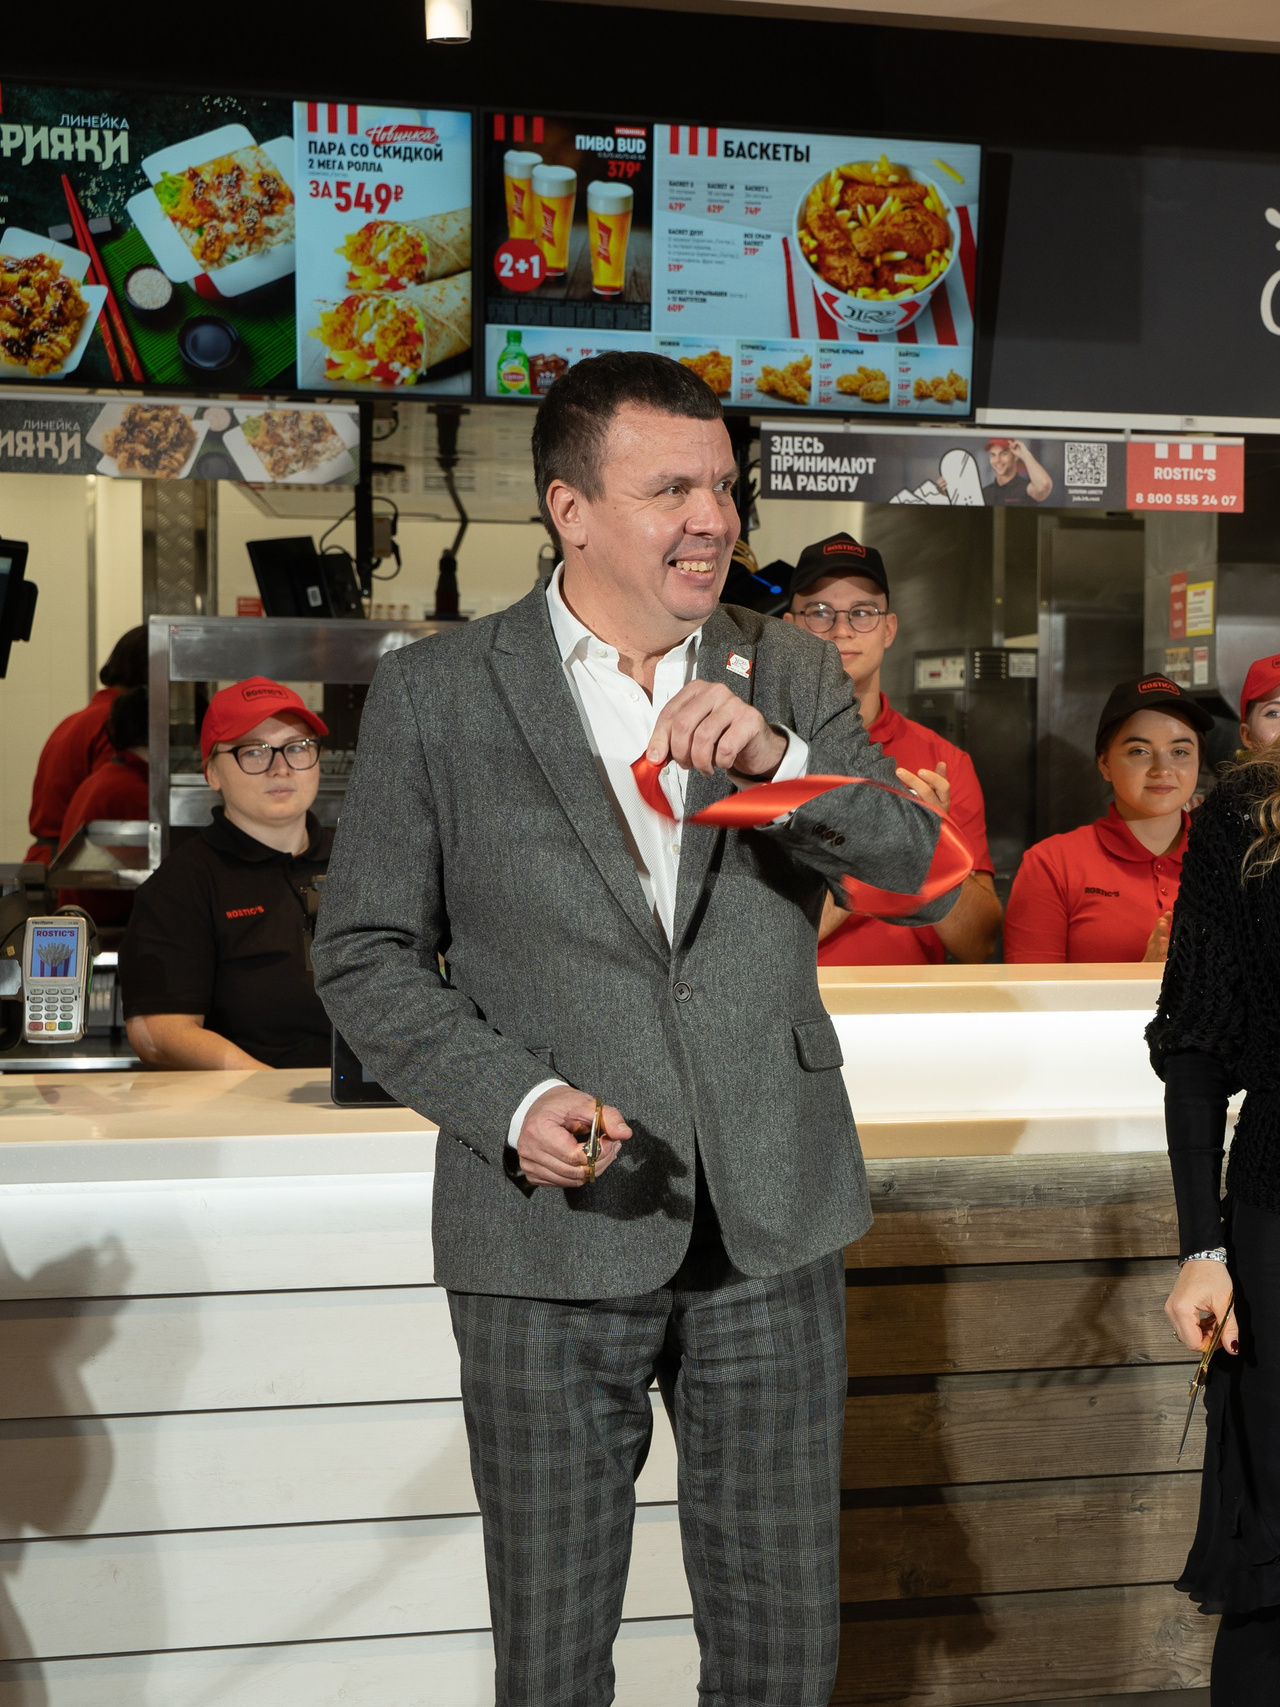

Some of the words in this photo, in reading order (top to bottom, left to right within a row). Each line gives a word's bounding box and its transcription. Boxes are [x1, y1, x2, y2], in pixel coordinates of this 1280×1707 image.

[60, 113, 130, 130] ЛИНЕЙКА
[308, 141, 347, 156] ПАРА
[350, 144, 369, 158] СО
[373, 143, 443, 162] СКИДКОЙ
[575, 135, 614, 152] ПИВО
[617, 138, 647, 153] BUD
[723, 140, 811, 163] БАСКЕТЫ
[308, 159, 315, 169] 2
[317, 160, 345, 171] МЕГА
[347, 162, 383, 173] РОЛЛА
[309, 180, 332, 198] ЗА
[499, 252, 540, 279] 2+1
[23, 418, 81, 431] ЛИНЕЙКА
[771, 435, 825, 456] ЗДЕСЬ
[771, 454, 877, 475] ПРИНИМАЮТ
[1154, 466, 1217, 482] ROSTIC'S
[771, 474, 794, 491] НА
[796, 474, 860, 493] РАБОТУ
[1135, 492, 1145, 504] 8
[1147, 492, 1173, 505] 800
[1175, 494, 1199, 505] 555
[1201, 495, 1218, 506] 24
[1220, 495, 1238, 507] 07
